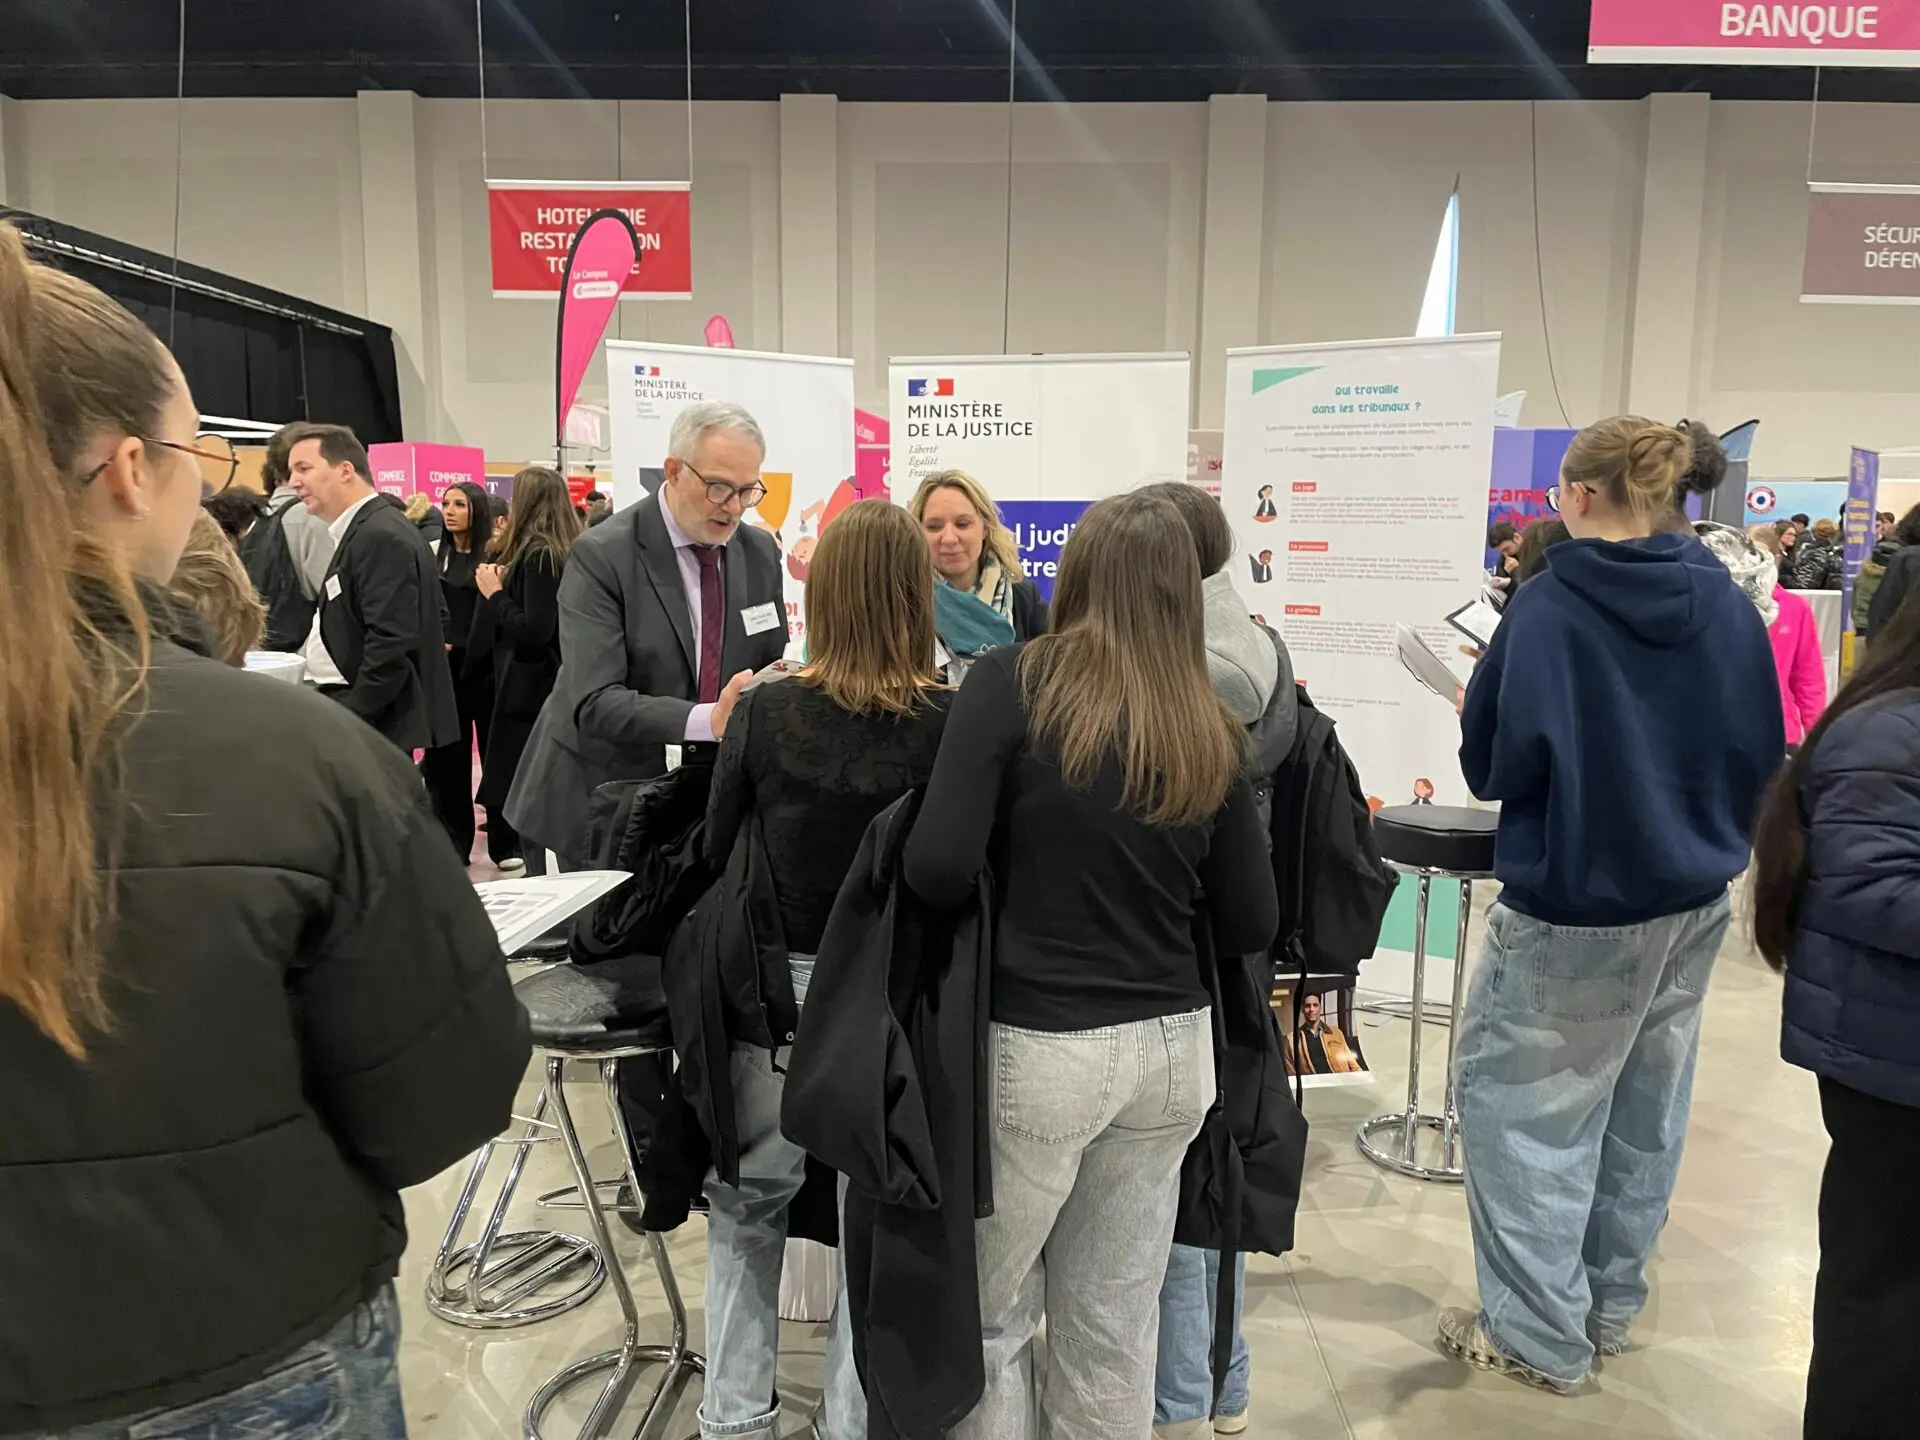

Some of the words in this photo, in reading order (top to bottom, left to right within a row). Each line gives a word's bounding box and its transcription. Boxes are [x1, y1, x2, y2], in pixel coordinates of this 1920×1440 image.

[1720, 3, 1879, 44] BANQUE
[537, 207, 646, 226] HOTEIE
[520, 232, 661, 250] RESTAON
[634, 379, 688, 390] MINISTÈRE
[1355, 384, 1399, 395] travaille
[635, 389, 648, 398] DE
[650, 390, 663, 398] LA
[665, 391, 704, 400] JUSTICE
[908, 400, 1003, 419] MINISTÈRE
[1312, 404, 1336, 414] dans
[1339, 404, 1354, 413] les
[1359, 402, 1410, 412] tribunaux
[1414, 401, 1421, 411] ?
[908, 423, 930, 437] DE
[936, 423, 958, 437] LA
[962, 422, 1033, 439] JUSTICE
[908, 444, 938, 454] Liberté
[429, 471, 472, 483] COMMERCE
[1488, 489, 1547, 507] camp
